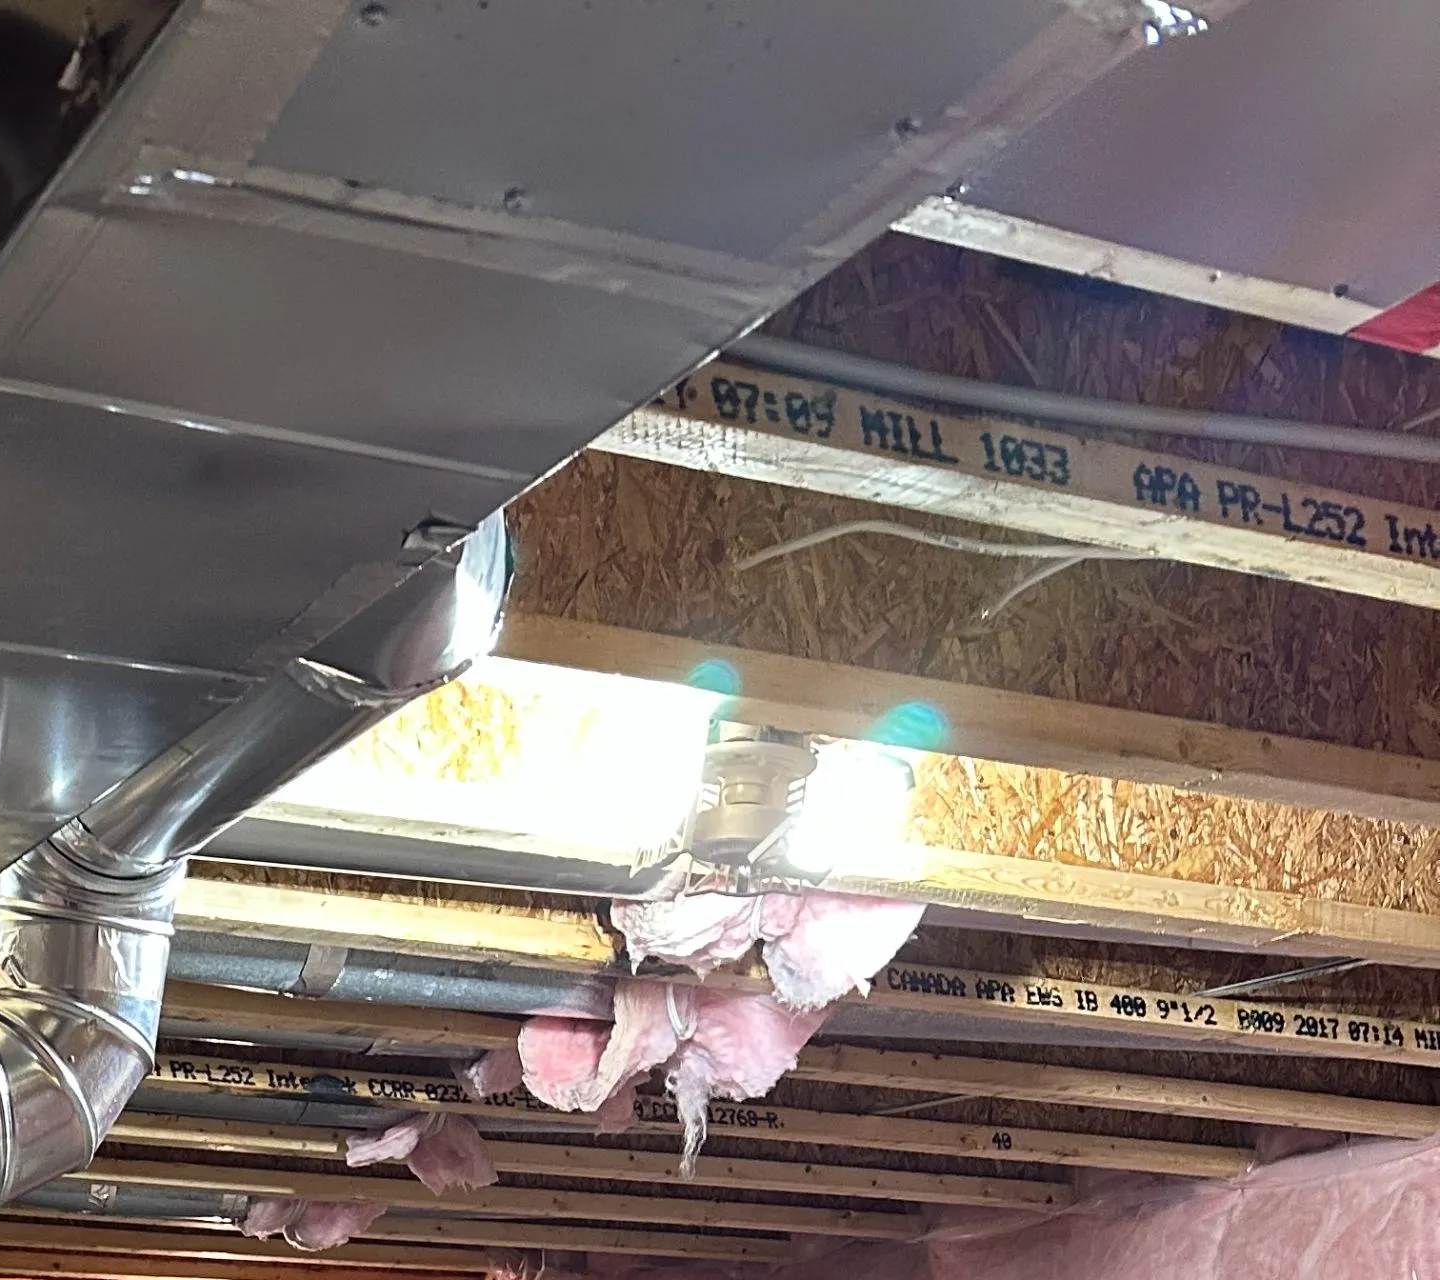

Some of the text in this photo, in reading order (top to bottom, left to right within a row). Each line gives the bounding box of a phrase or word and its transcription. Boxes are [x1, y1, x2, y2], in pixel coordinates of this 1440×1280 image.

[711, 377, 837, 439] 07:09
[860, 404, 960, 465] MILL
[980, 432, 1070, 485] 1033
[1133, 463, 1201, 511] APA
[1216, 479, 1367, 547] PR-L252
[887, 967, 966, 997] CANADA
[976, 976, 1015, 1002] APA
[1075, 989, 1099, 1012] IB
[1110, 994, 1147, 1017] 400
[1293, 1014, 1339, 1039] 2017
[1348, 1020, 1404, 1047] 07:14
[169, 1060, 256, 1086] PR-L252
